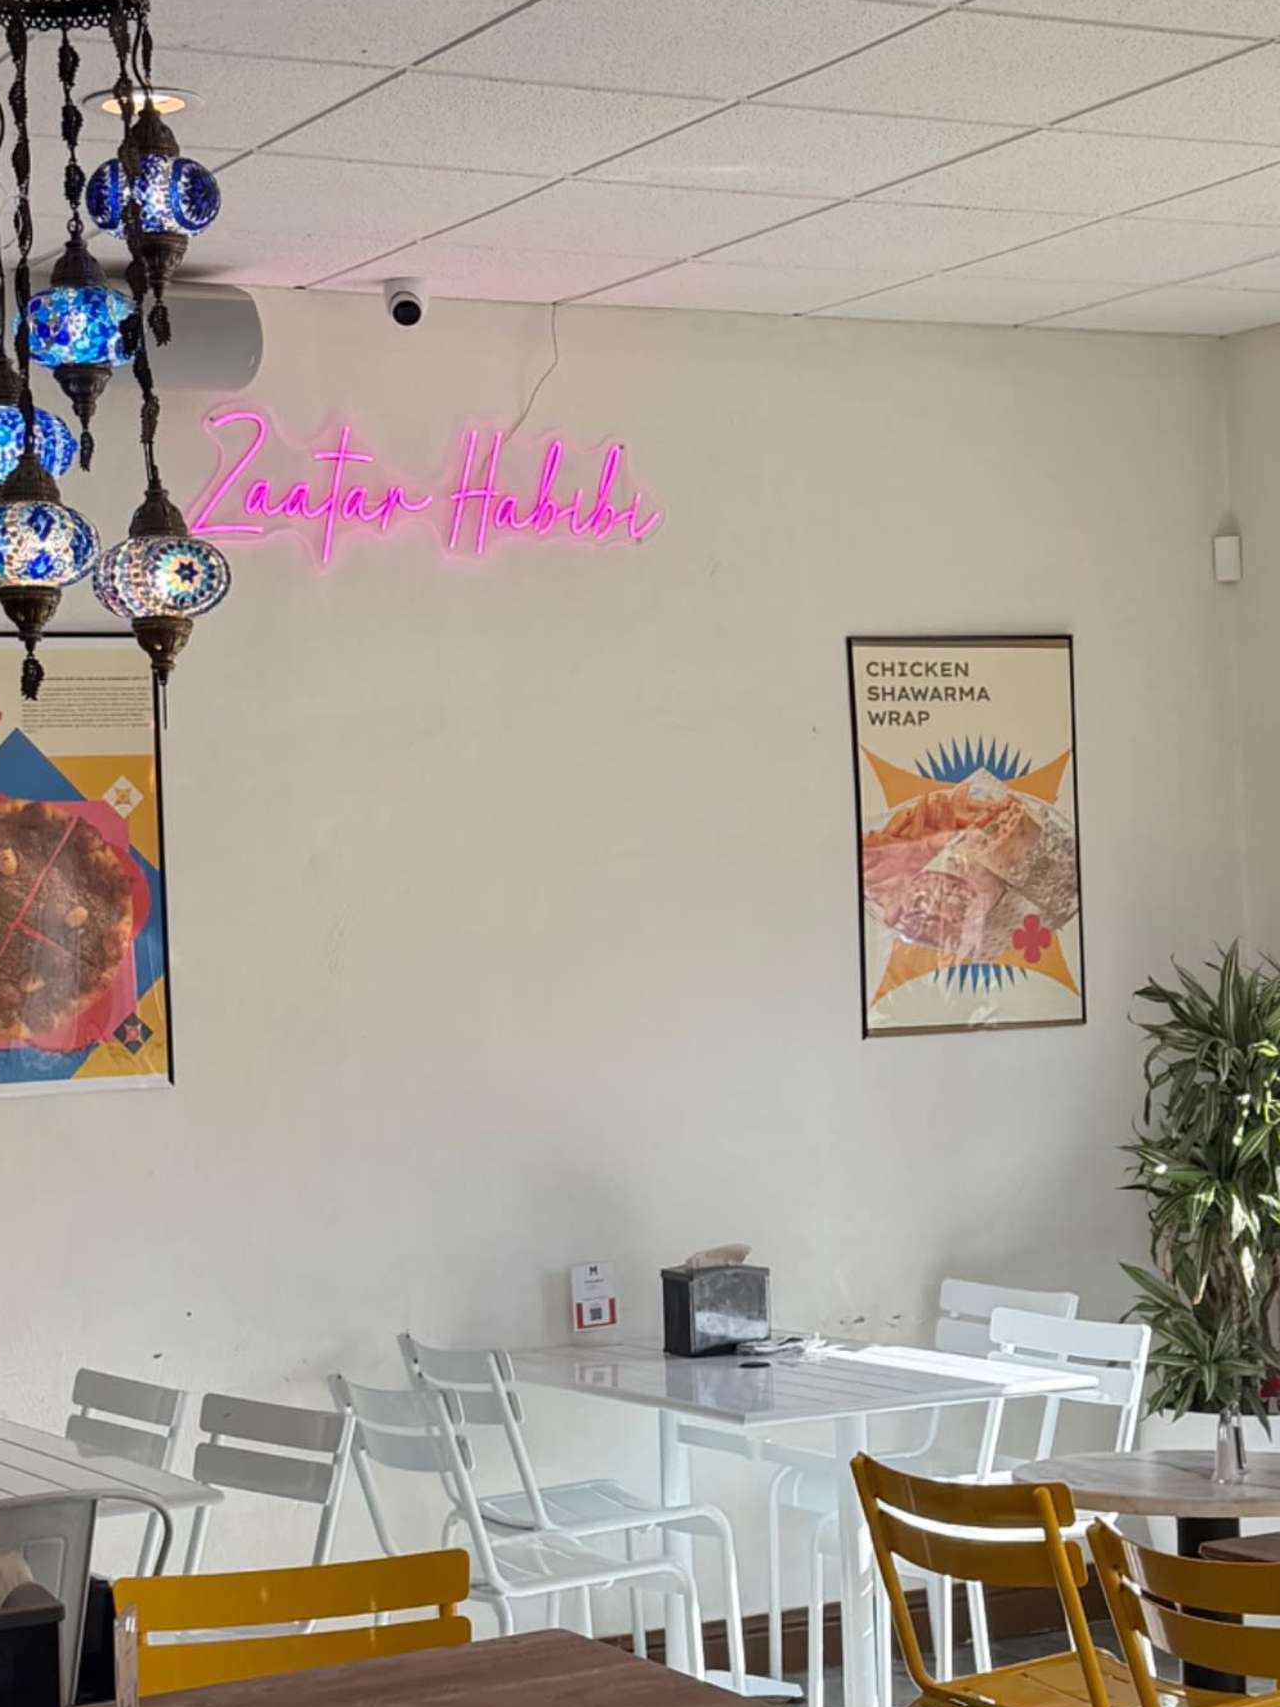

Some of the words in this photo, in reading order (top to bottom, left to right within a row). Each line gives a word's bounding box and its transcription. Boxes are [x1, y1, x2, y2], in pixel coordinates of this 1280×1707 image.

[190, 410, 433, 563] Zaatar
[449, 429, 661, 555] Habibi
[865, 660, 970, 678] CHICKEN
[866, 685, 991, 702] SHAWARMA
[867, 709, 931, 727] WRAP
